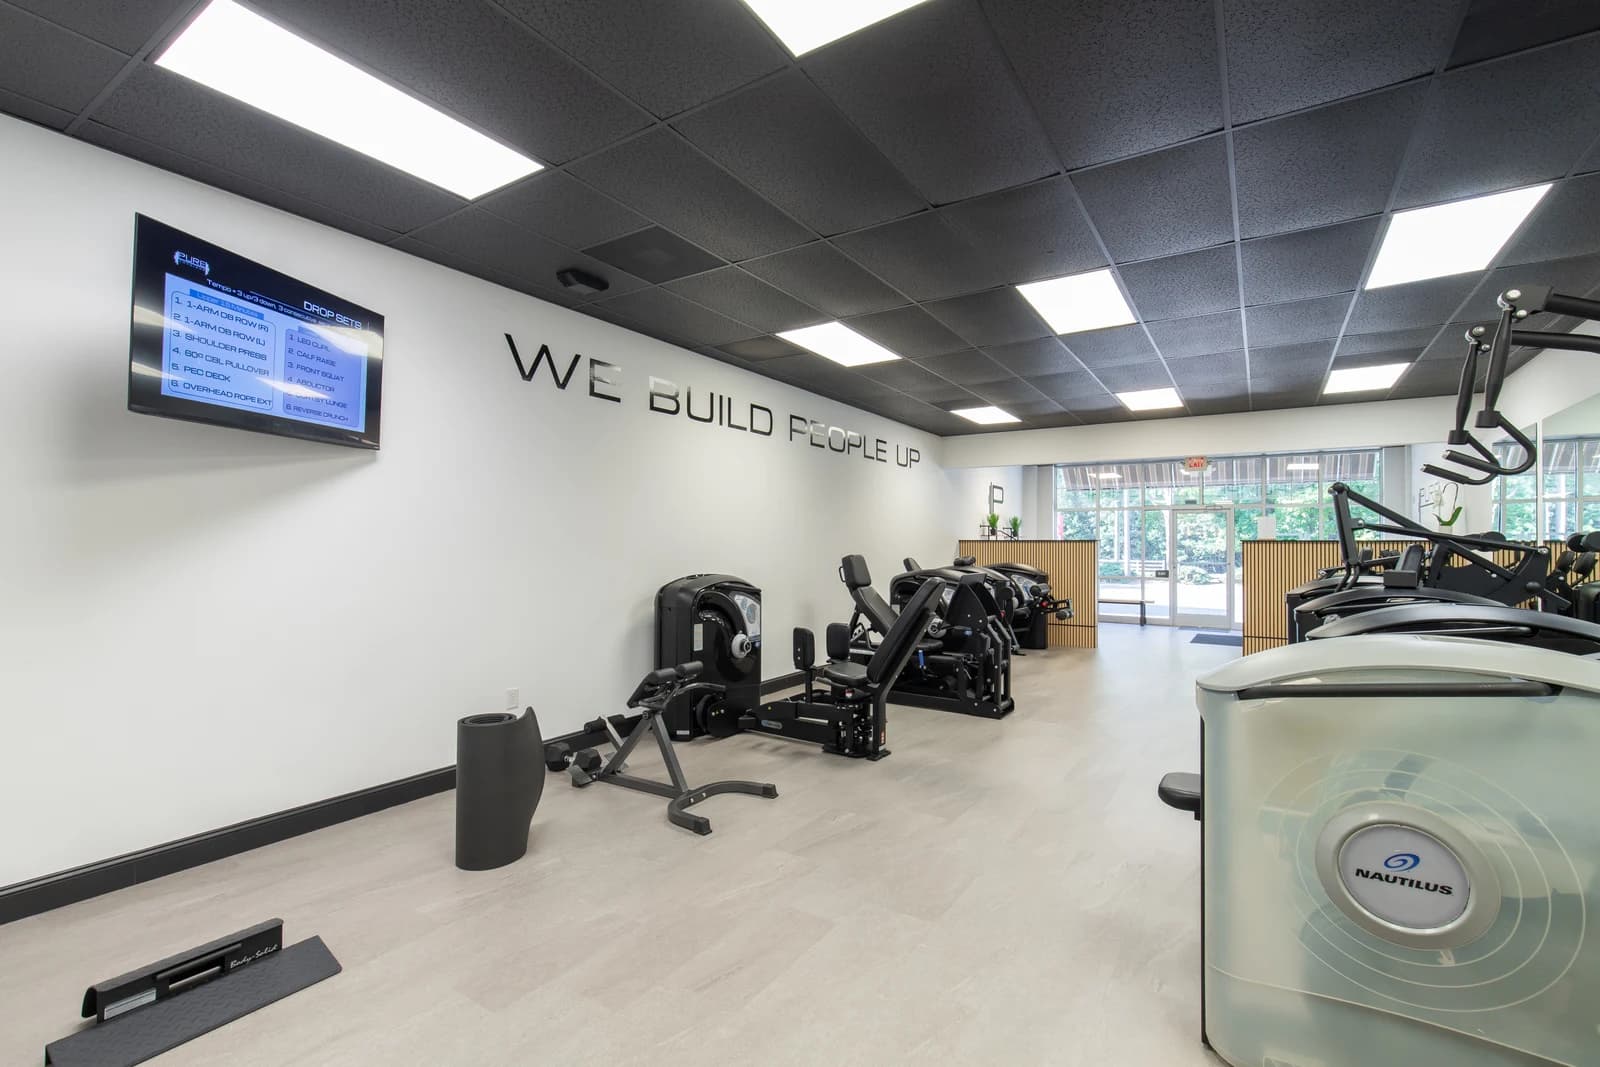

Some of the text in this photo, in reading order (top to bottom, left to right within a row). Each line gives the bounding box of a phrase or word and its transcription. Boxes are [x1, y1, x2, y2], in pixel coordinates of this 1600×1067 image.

[207, 278, 232, 293] Tempo
[186, 301, 220, 316] 1-ARM
[220, 311, 234, 321] DB
[234, 316, 258, 328] ROW
[257, 323, 269, 333] (R)
[303, 301, 335, 319] DROP
[335, 313, 362, 330] SETS
[184, 316, 217, 332] 1-ARM
[218, 326, 232, 337] DB
[232, 331, 256, 343] ROW
[255, 337, 266, 347] (L)
[184, 333, 237, 352] SHOULDER
[238, 348, 267, 361] PRESS
[296, 350, 316, 361] CALF
[315, 356, 337, 367] RAISE
[183, 365, 204, 376] PEC
[205, 370, 231, 383] DECK
[204, 354, 225, 365] CBL
[225, 359, 270, 377] PULLOVER
[295, 363, 321, 376] FRONT
[320, 371, 345, 382] SQUAT
[182, 382, 233, 398] OVERHEAD
[234, 393, 257, 404] ROPE
[256, 399, 272, 407] EXT
[503, 332, 921, 468] WE BUILD PEOPLE UP
[292, 405, 323, 417] REVERSE
[1354, 867, 1454, 896] NAUTILUS
[229, 943, 279, 968] Body-Solid
